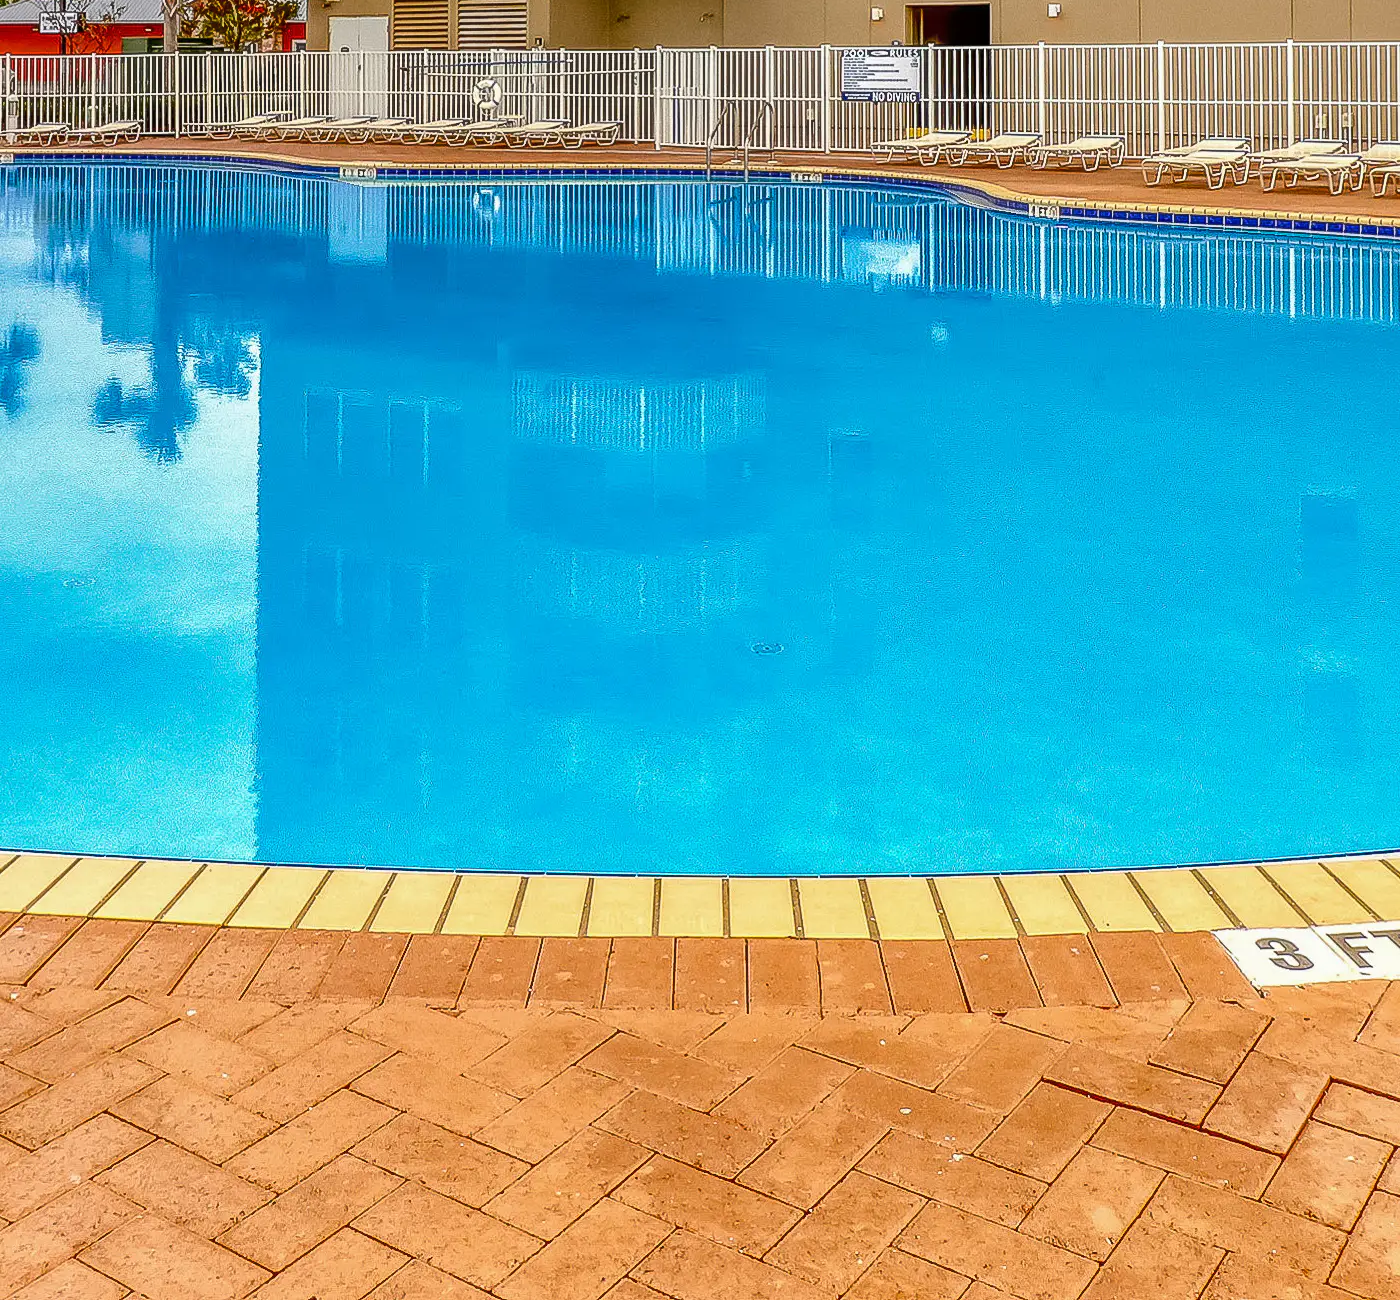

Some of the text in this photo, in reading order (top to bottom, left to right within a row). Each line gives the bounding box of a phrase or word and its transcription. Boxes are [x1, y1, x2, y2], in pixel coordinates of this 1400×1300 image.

[843, 49, 919, 58] POOL RULES
[872, 92, 885, 102] NO
[887, 92, 917, 103] DIVING
[1255, 937, 1315, 970] 3
